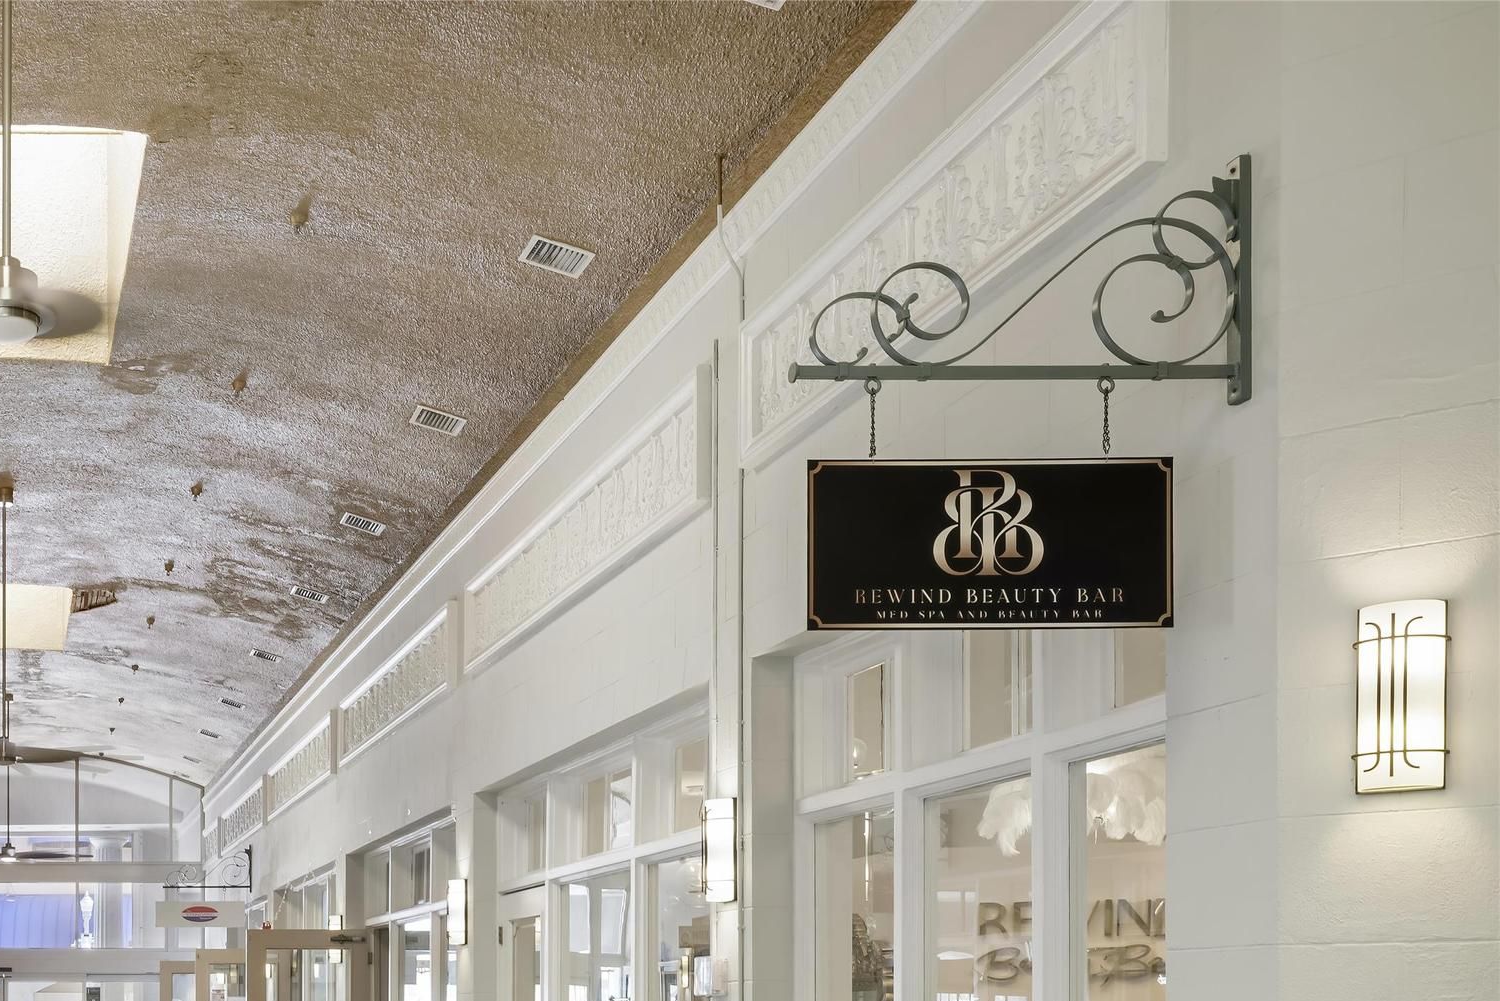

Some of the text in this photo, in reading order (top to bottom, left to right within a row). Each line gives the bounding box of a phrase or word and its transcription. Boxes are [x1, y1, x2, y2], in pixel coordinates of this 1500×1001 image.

[855, 587, 1125, 604] REWIND BEAUTY BAR
[876, 610, 1103, 619] MED SPA AND BEAUTY BAR
